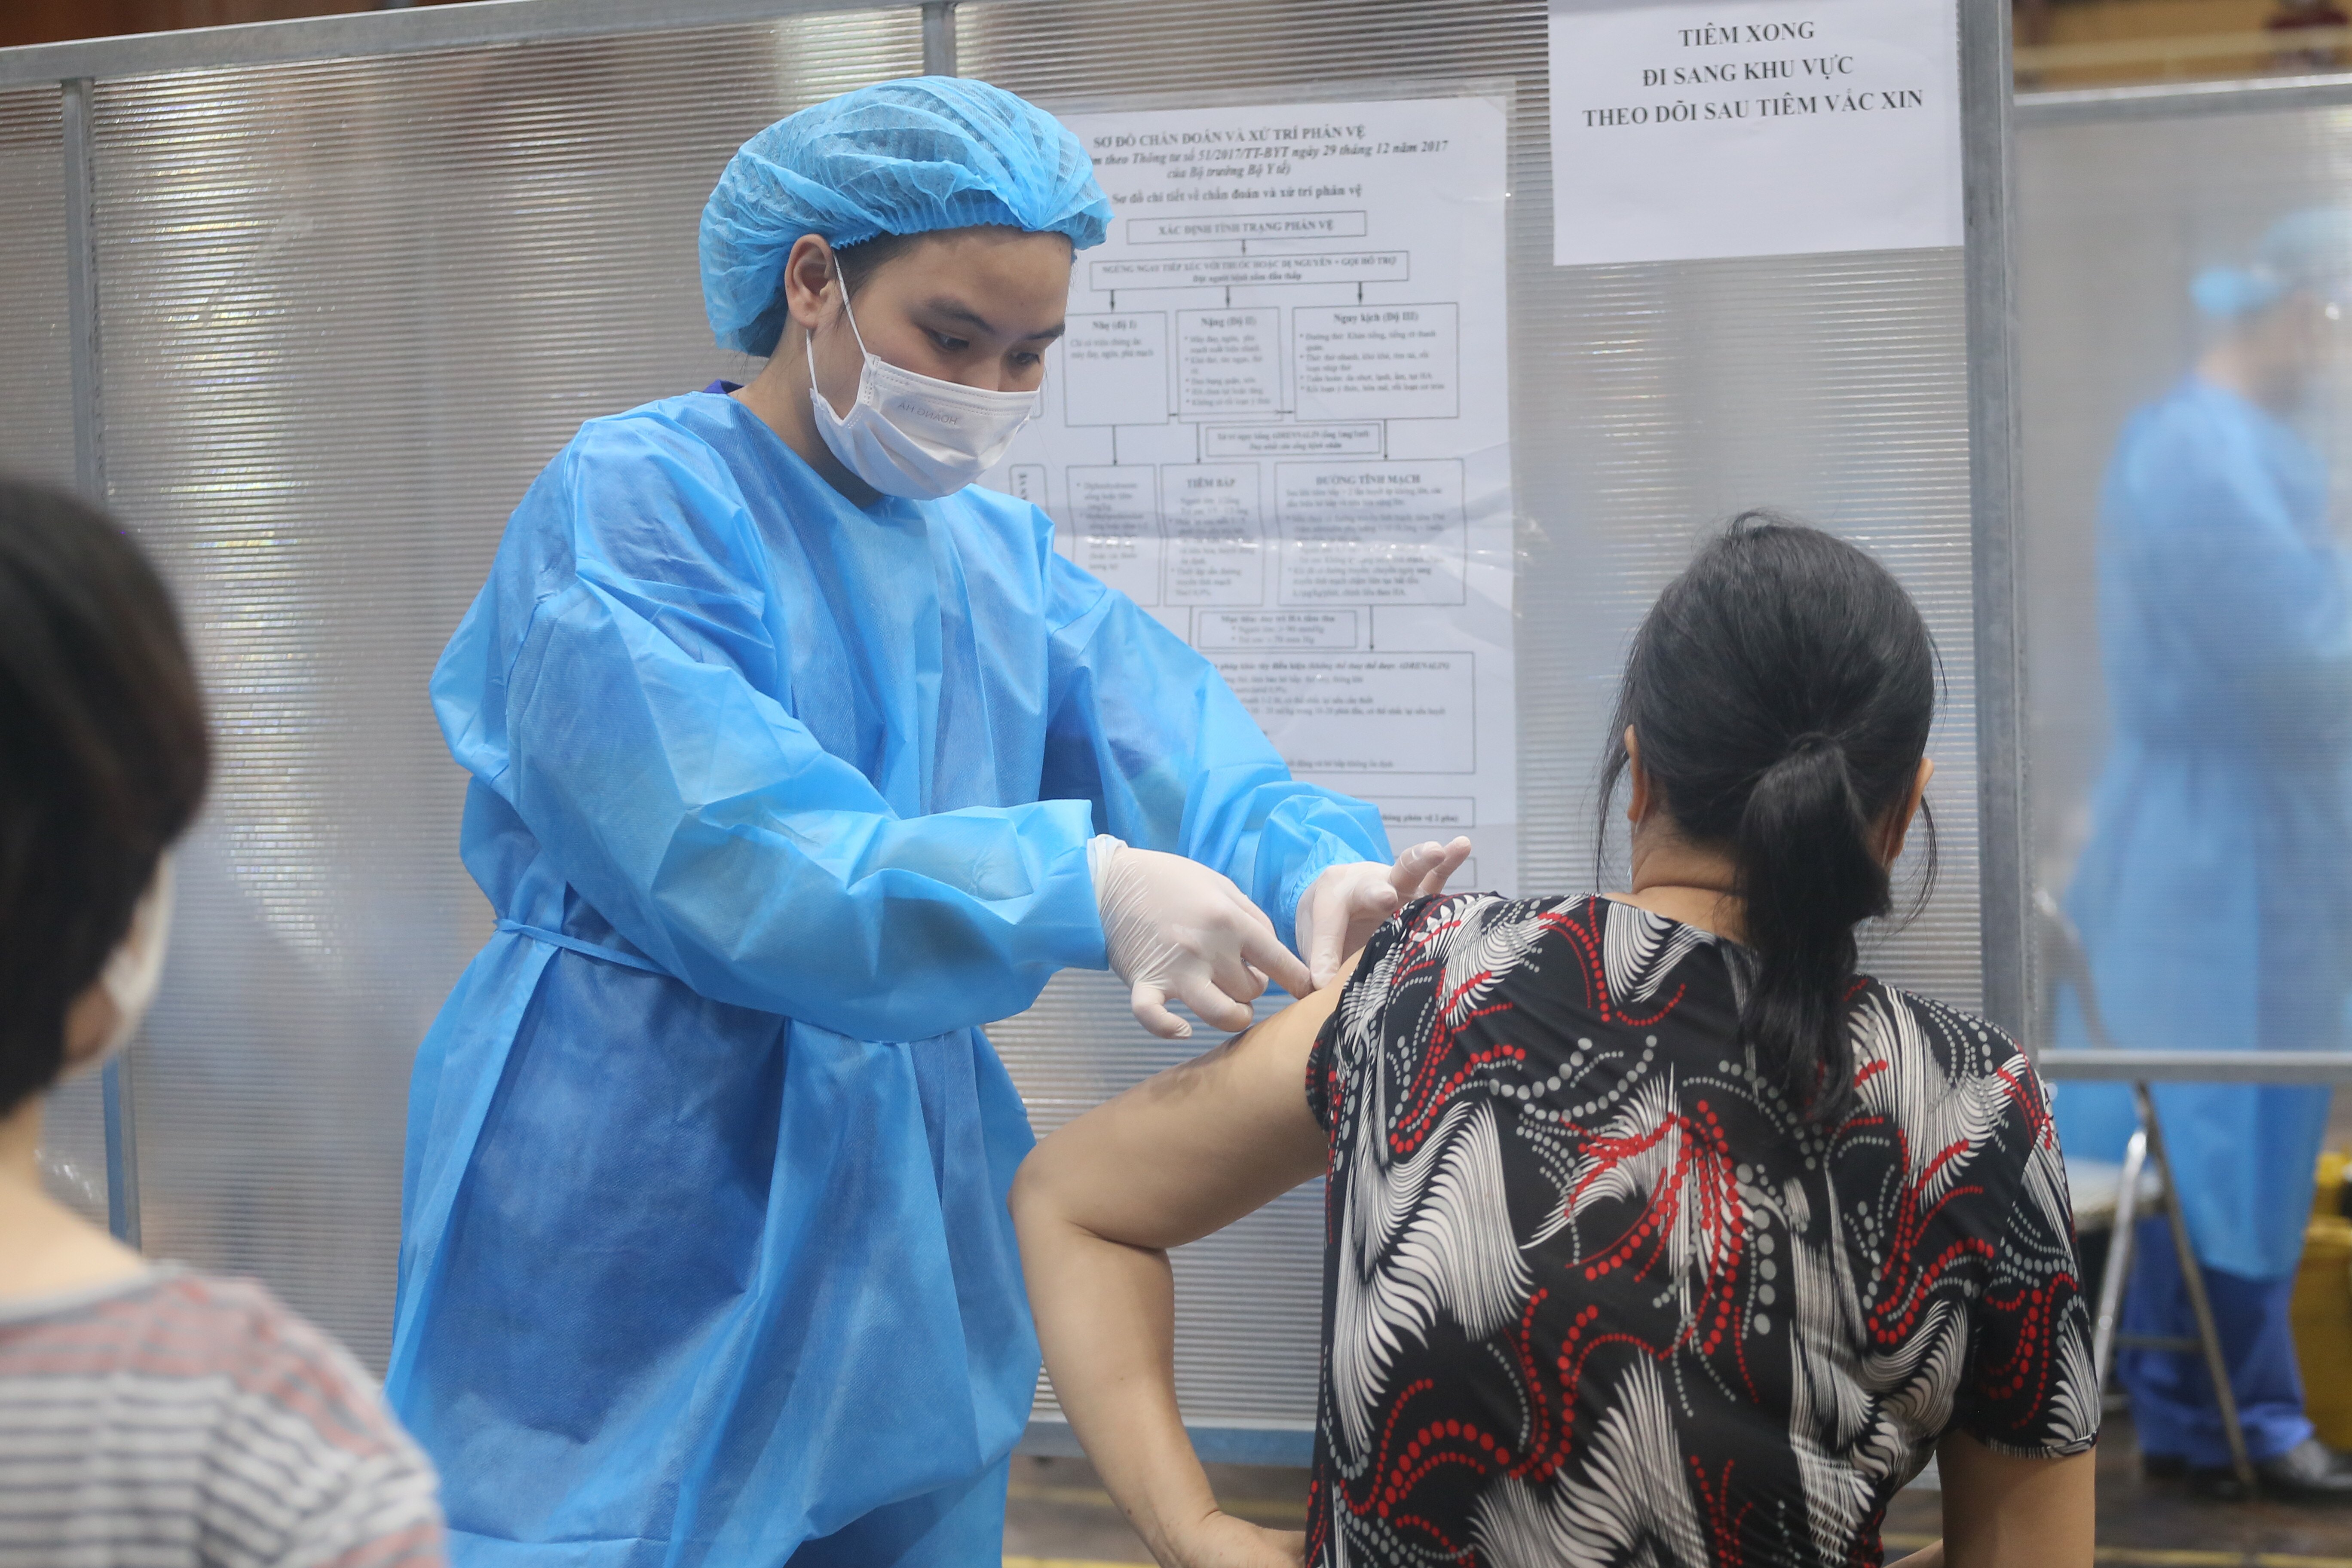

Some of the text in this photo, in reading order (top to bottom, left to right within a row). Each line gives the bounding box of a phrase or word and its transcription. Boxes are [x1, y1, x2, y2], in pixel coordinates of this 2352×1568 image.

[1678, 21, 1814, 47] TIÊM XONG
[1643, 54, 1853, 86] ĐI SANG KHU VỰC
[1583, 88, 1923, 127] THEO DÕI SAU TIÊM VẮC XIN
[1105, 154, 1129, 165] theo
[1322, 144, 1337, 156] 29
[1376, 142, 1390, 154] 12
[1421, 140, 1449, 153] 2017
[1266, 163, 1275, 175] Y
